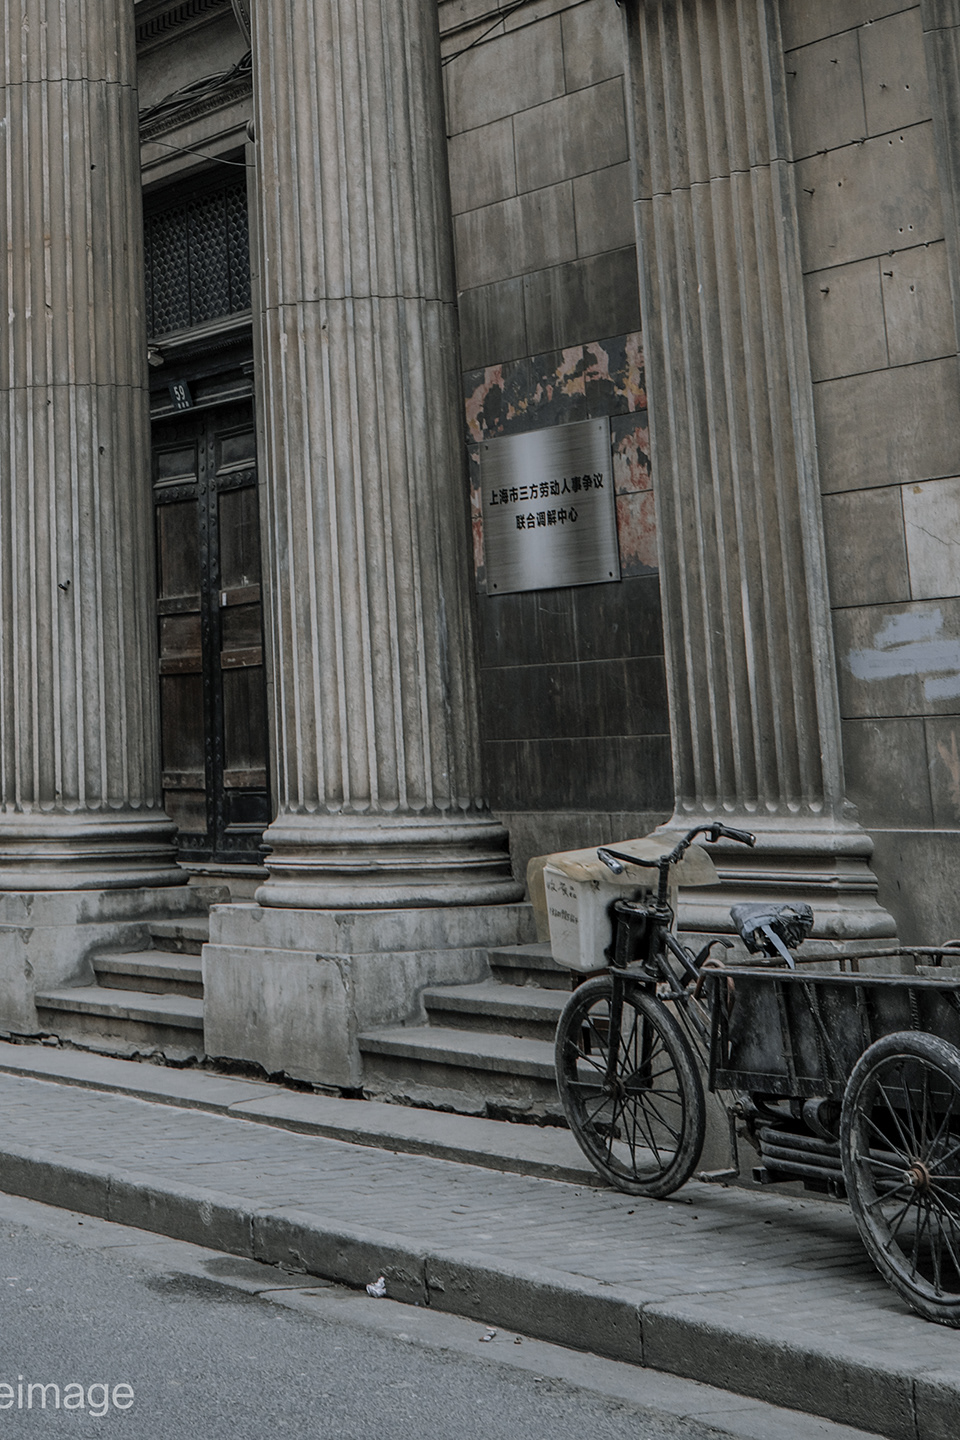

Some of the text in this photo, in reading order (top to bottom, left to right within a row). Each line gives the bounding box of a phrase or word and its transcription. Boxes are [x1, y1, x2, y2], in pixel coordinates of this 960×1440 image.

[173, 385, 186, 401] 59
[489, 473, 604, 506] 上海市三方劳动人事争议
[515, 507, 578, 530] 联合调解中心
